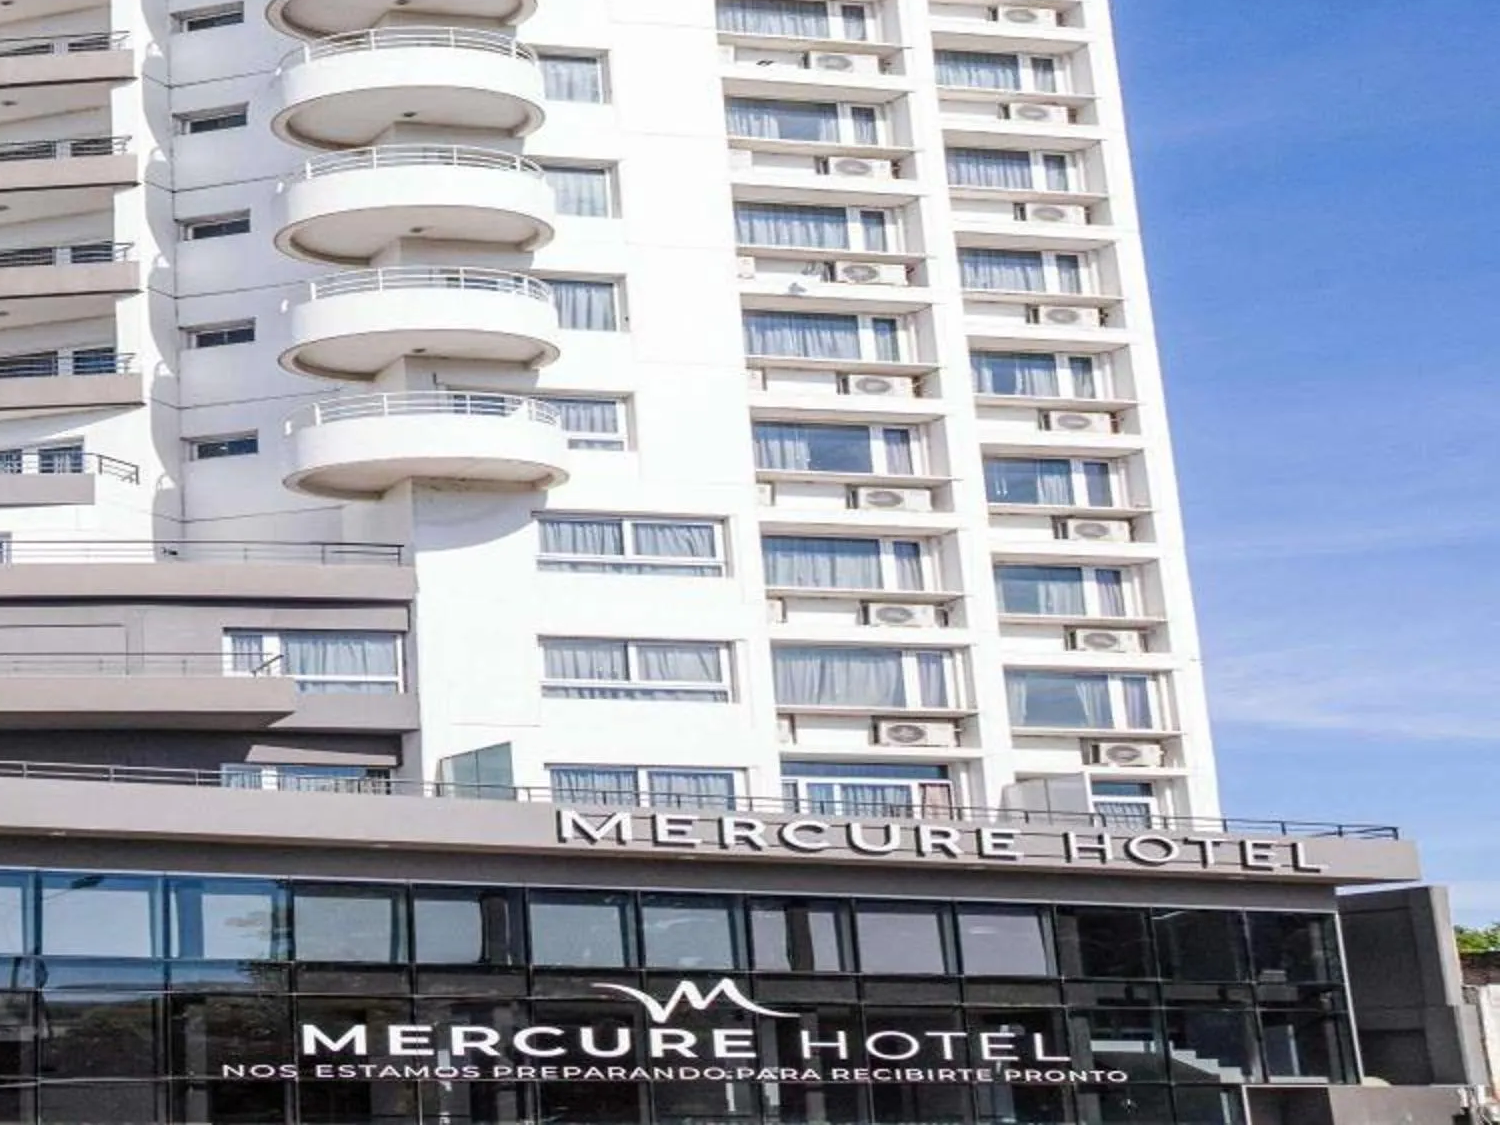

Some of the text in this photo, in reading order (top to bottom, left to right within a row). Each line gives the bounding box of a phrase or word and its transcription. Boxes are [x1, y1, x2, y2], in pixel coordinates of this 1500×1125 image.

[556, 810, 1328, 873] MERCURE HOTEL
[301, 1023, 1071, 1063] MERCURE HOTEL
[222, 1064, 1129, 1084] NOS ESTAMOS PREPARANDO PARA RECIBIRTE PRONTO
